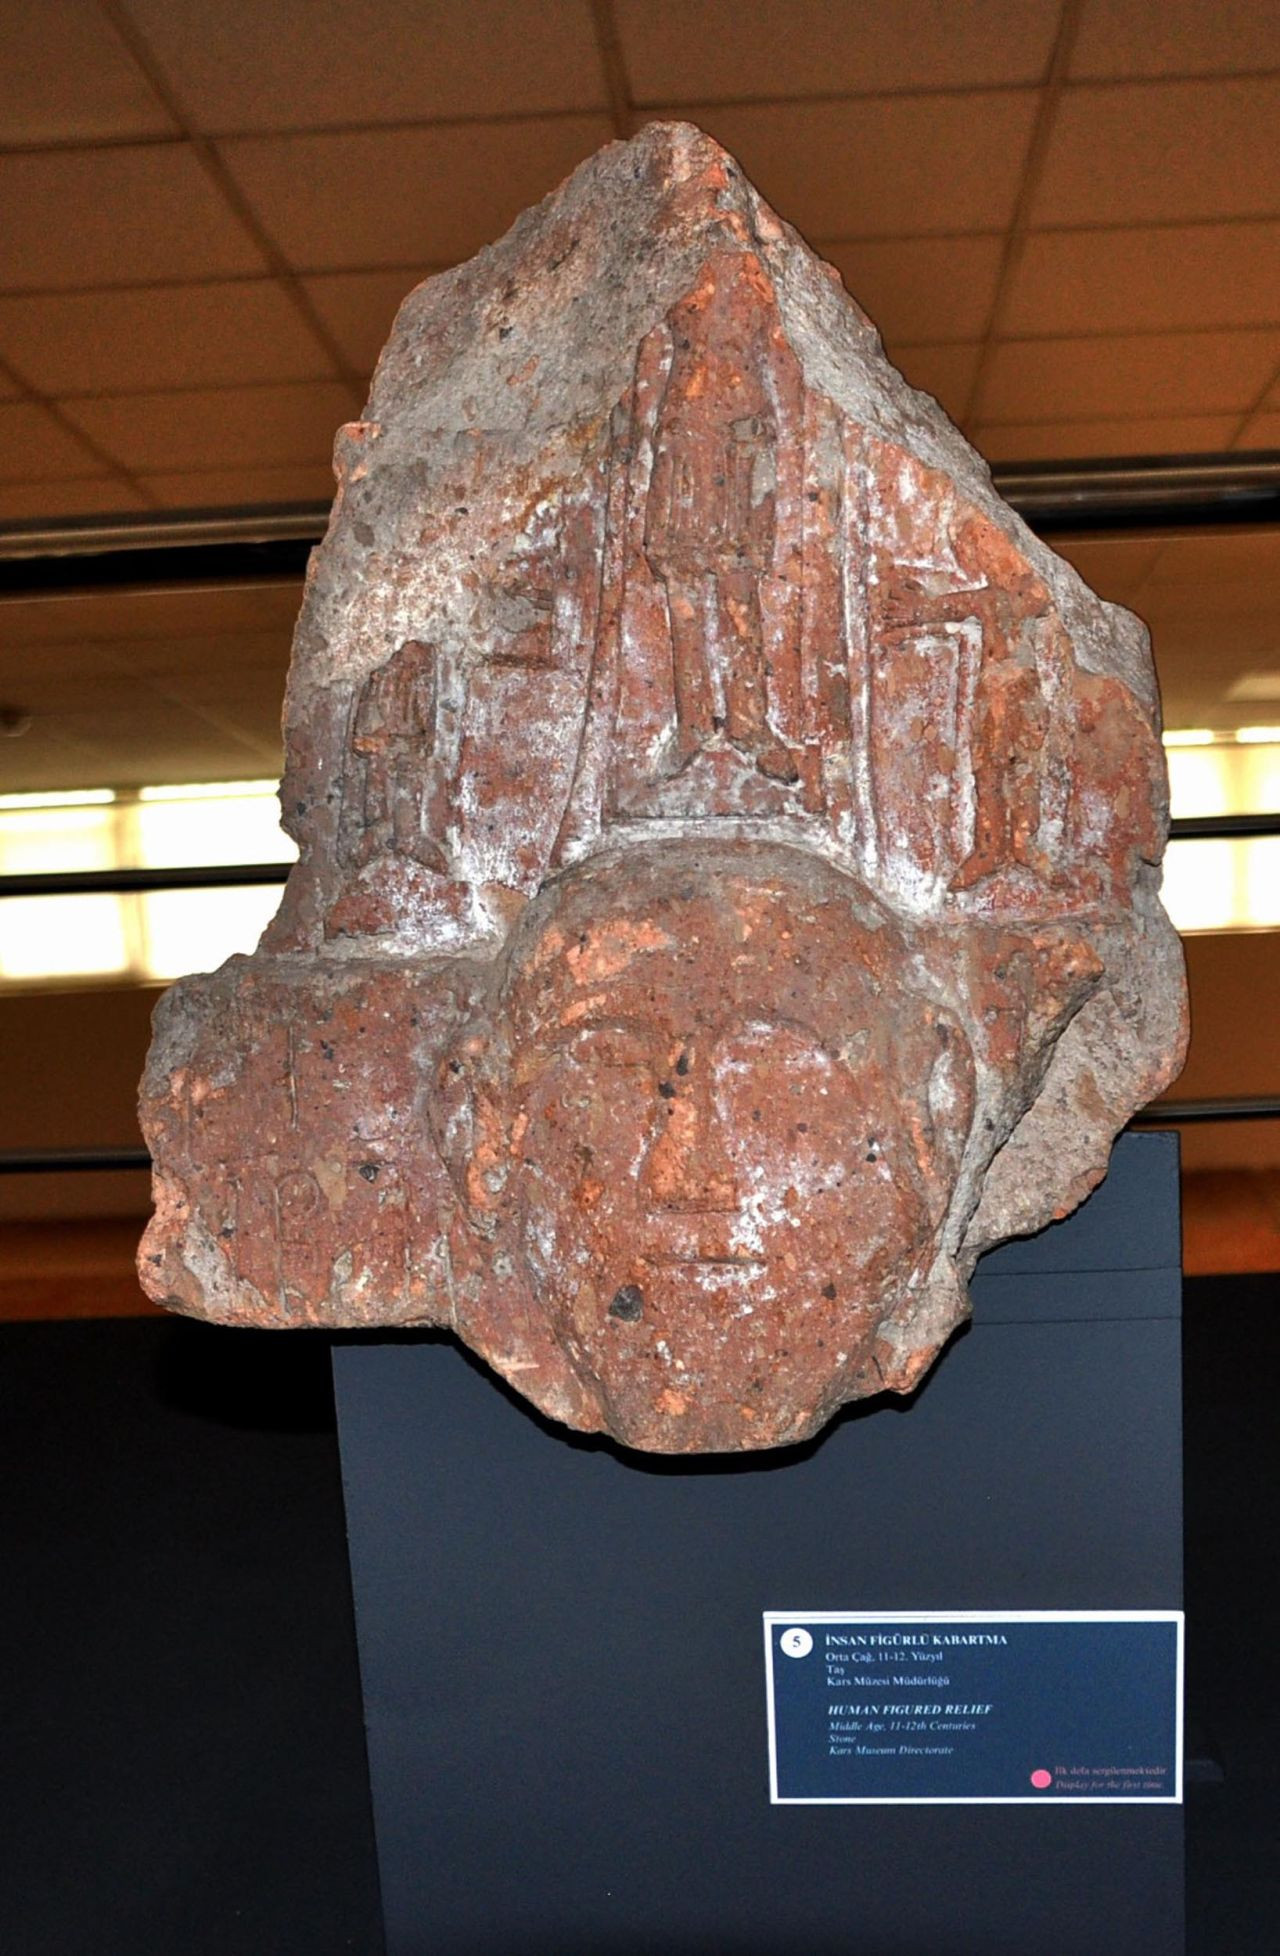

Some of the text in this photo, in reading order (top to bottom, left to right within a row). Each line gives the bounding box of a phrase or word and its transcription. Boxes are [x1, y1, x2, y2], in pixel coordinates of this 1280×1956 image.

[792, 1635, 802, 1648] 5
[825, 1632, 1008, 1646] İNSAN FİGÜRLÜ KABARTMA
[825, 1652, 849, 1662] Orta
[826, 1664, 845, 1676] Taş
[826, 1676, 950, 1687] Kars Müzesi Müdürlüğü
[828, 1704, 994, 1716] HUMAN FIGURED RELIEF
[829, 1721, 863, 1732] Middle
[890, 1721, 927, 1731] 11-12th
[929, 1721, 976, 1731] Centuries
[828, 1734, 857, 1744] Stone
[829, 1746, 954, 1756] Kars Museum Directorate
